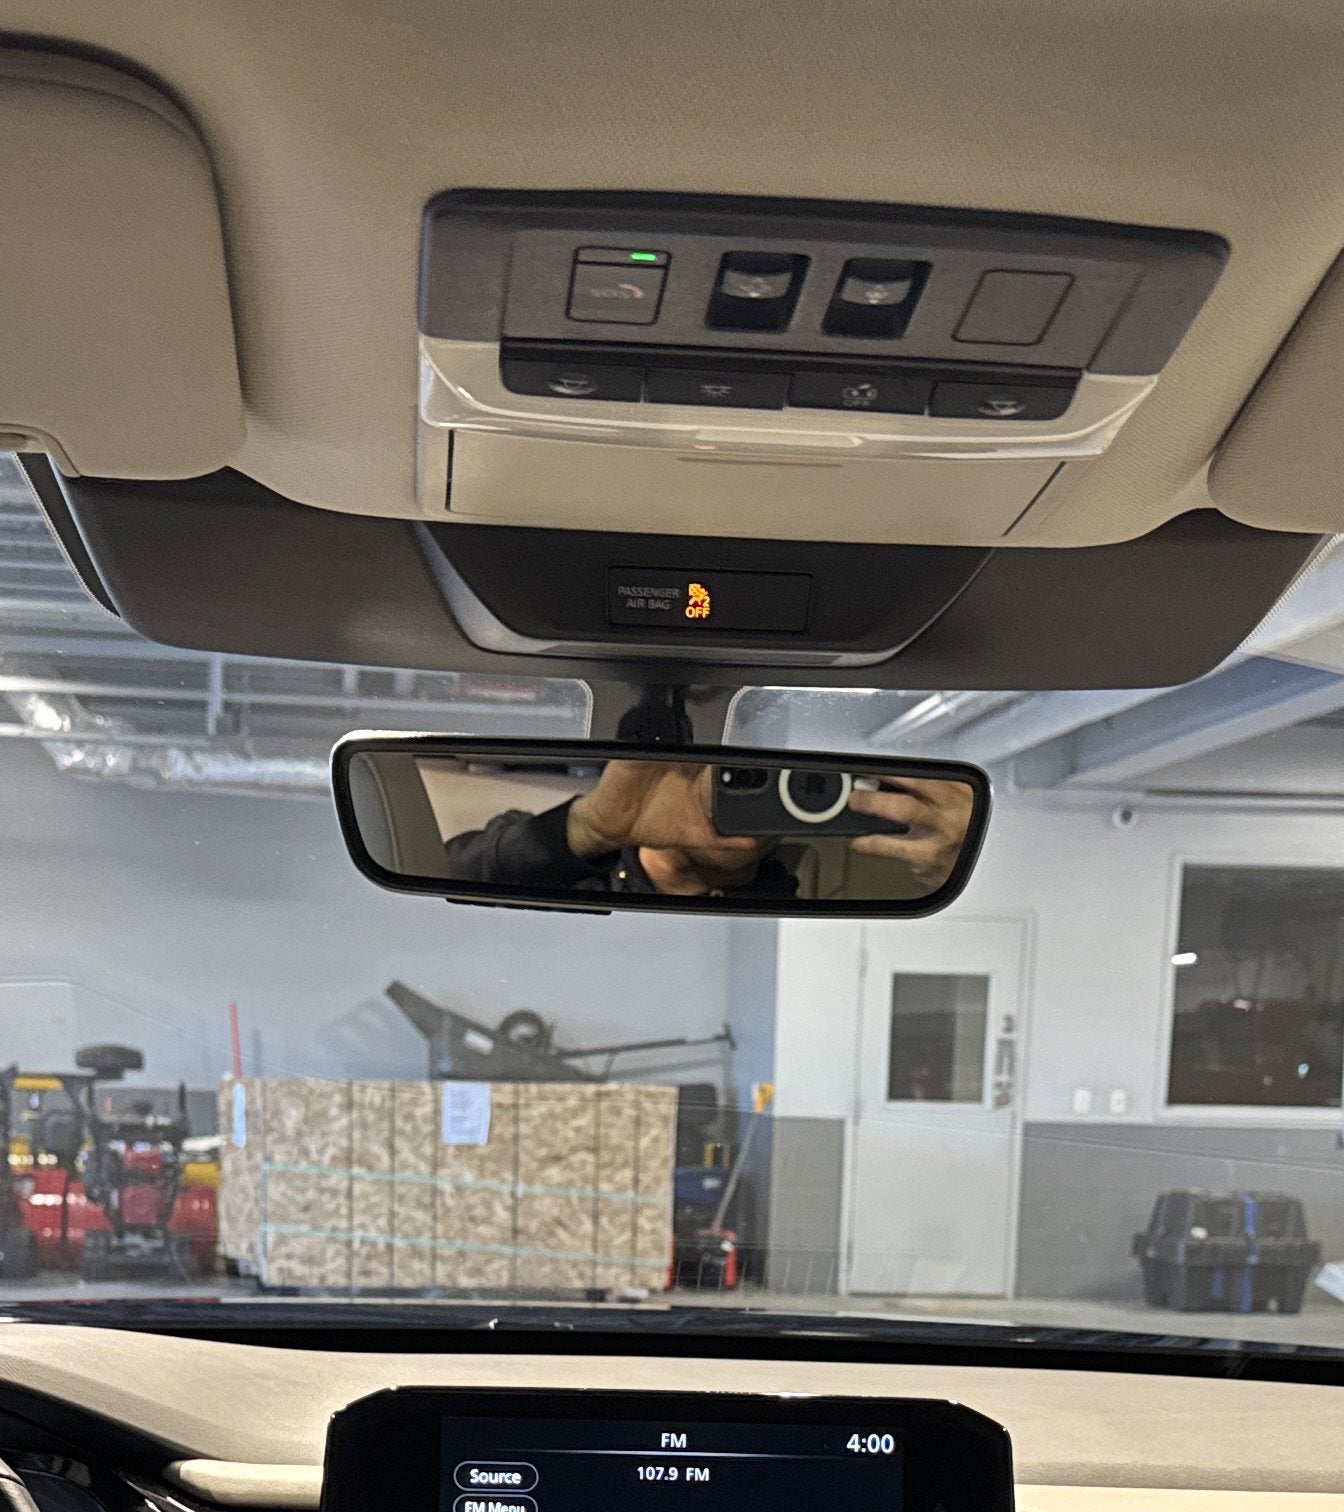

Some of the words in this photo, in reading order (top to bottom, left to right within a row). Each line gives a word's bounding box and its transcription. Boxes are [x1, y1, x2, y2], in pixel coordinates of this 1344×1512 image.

[617, 586, 681, 598] PASSENGER
[625, 598, 646, 608] AIR
[648, 599, 672, 610] BAG
[685, 606, 710, 618] OFF
[661, 1433, 687, 1448] FM
[846, 1433, 895, 1454] 4:00
[470, 1468, 522, 1485] Source
[637, 1466, 678, 1481] 107.9
[686, 1467, 710, 1481] FM
